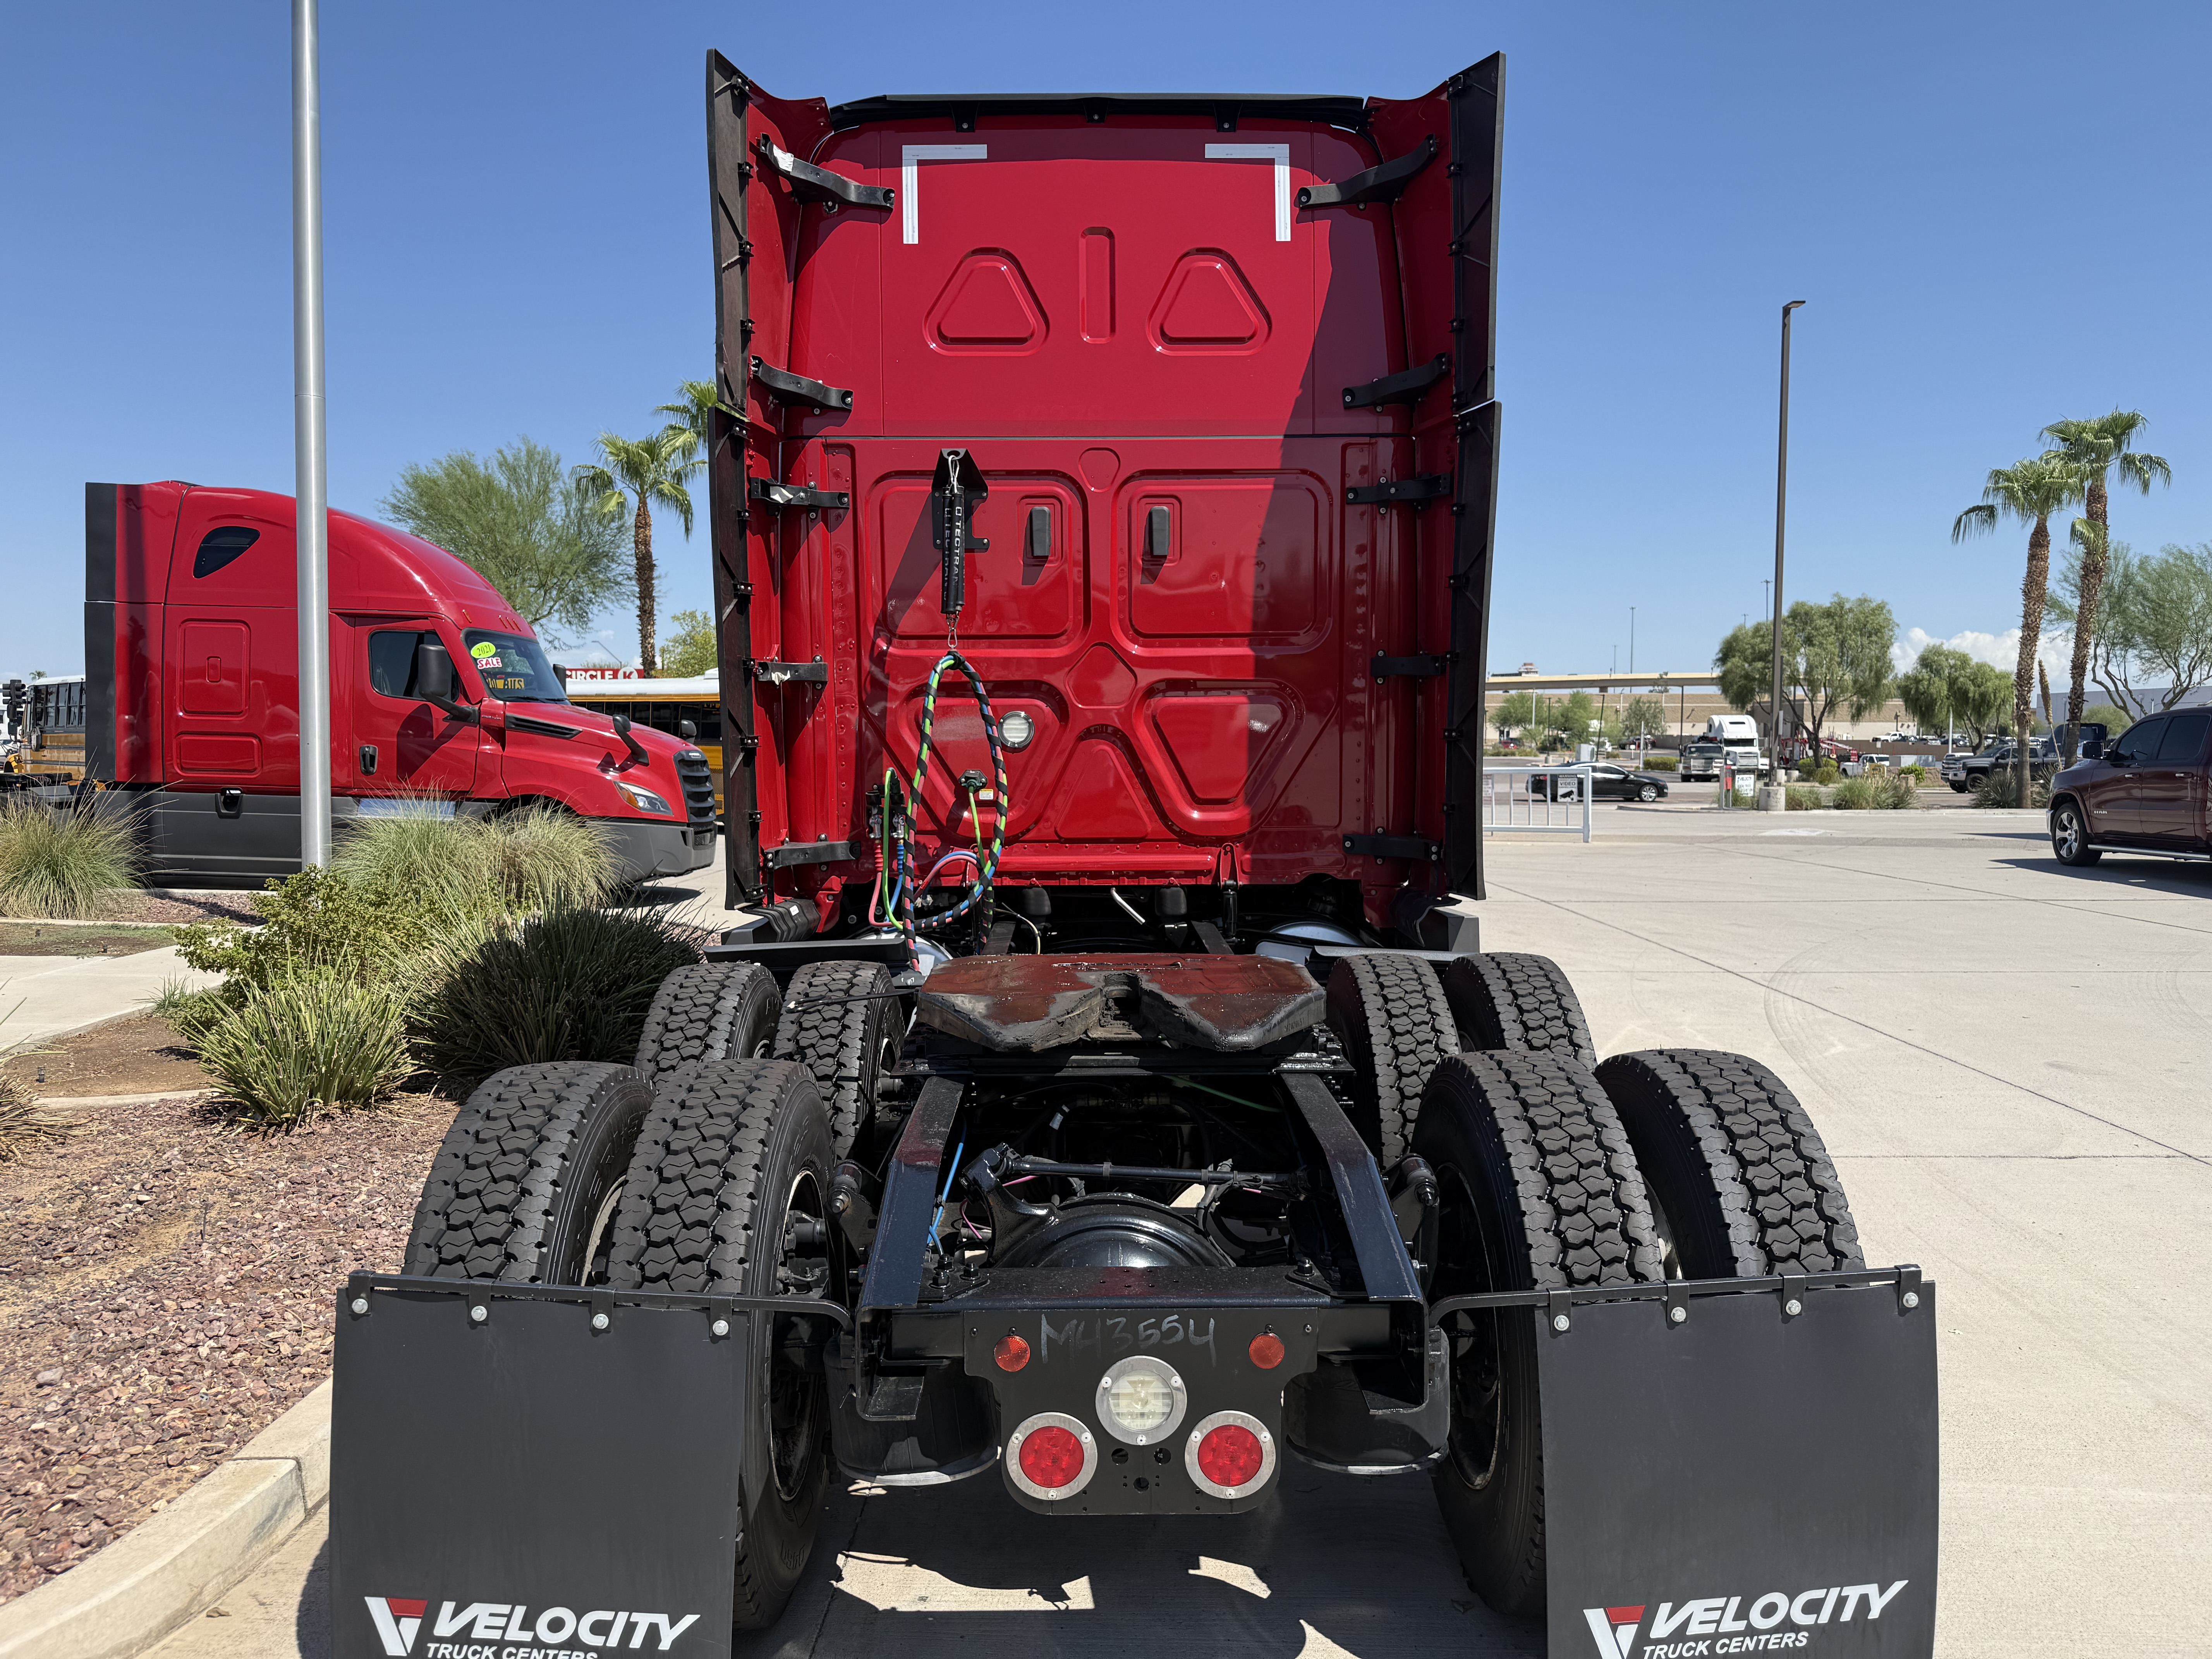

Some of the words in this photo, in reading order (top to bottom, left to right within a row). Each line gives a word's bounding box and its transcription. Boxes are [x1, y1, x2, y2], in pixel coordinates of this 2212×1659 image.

[952, 520, 961, 586] TECTRAN
[476, 644, 491, 656] 2021
[478, 658, 501, 668] SALE
[1649, 1580, 1909, 1638] VELOCITY
[433, 1600, 701, 1650] VELOCITY
[426, 1643, 498, 1659] TRUCK
[1643, 1640, 1711, 1659] TRUCK
[1715, 1631, 1809, 1655] CENTERS
